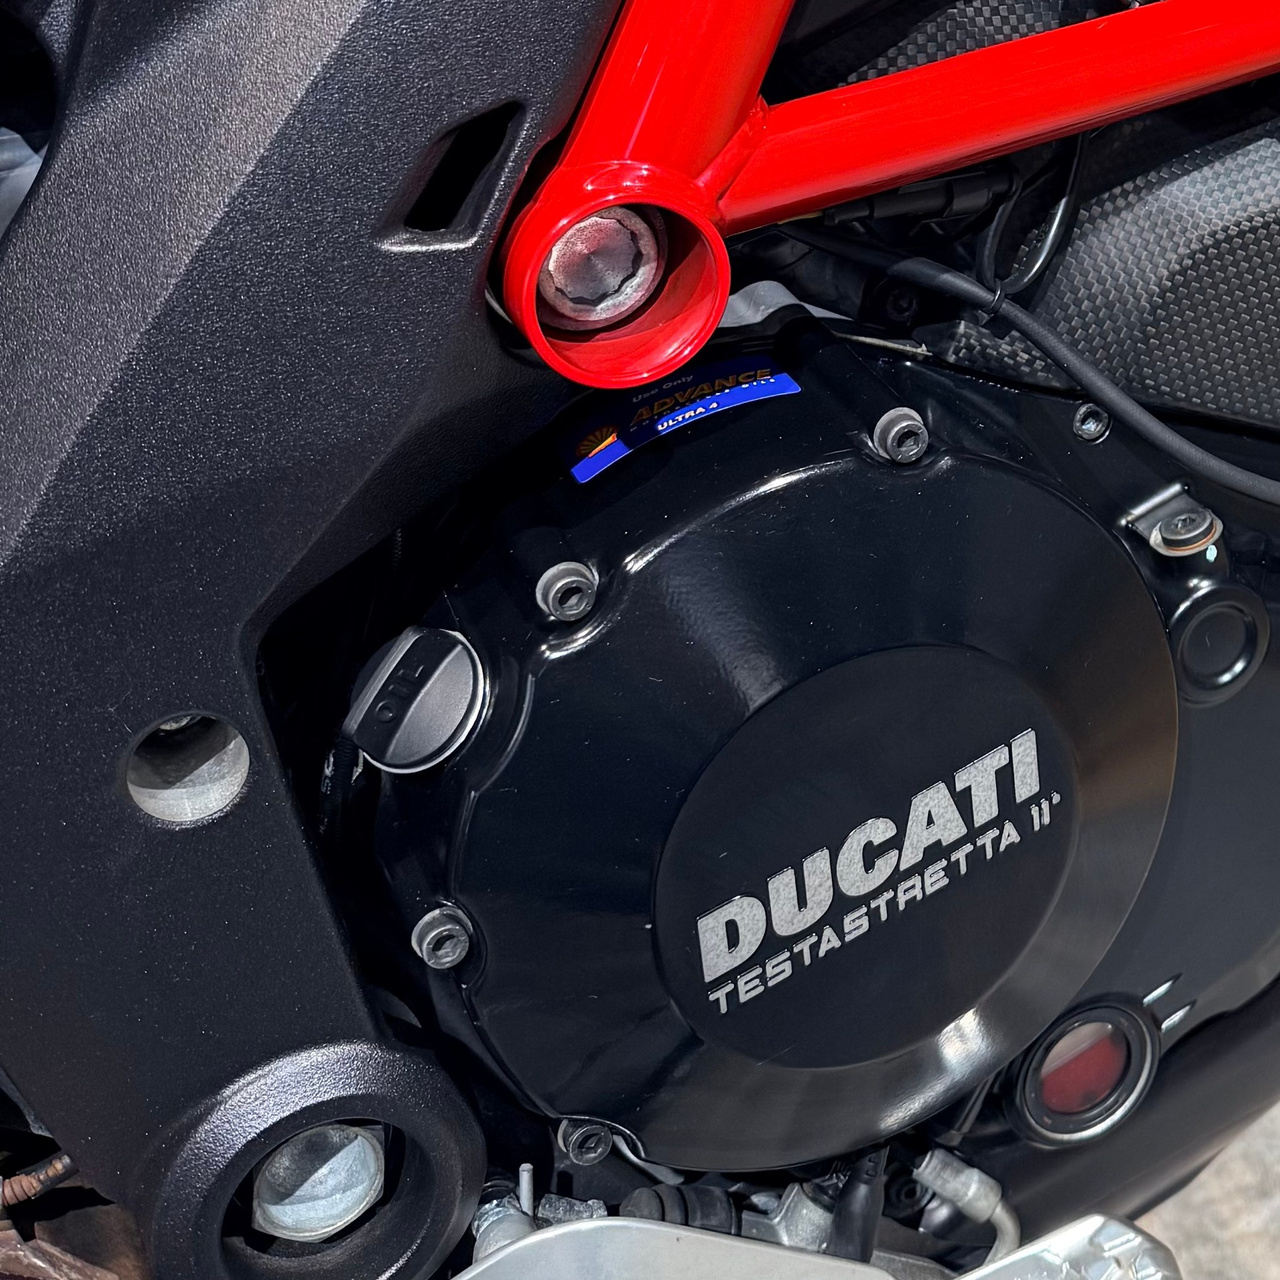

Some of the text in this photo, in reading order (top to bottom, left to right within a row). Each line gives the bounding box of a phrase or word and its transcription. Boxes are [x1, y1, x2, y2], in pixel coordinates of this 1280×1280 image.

[629, 368, 772, 426] ADVANCE
[632, 375, 694, 403] Use Only
[657, 401, 720, 431] ULTRA 4
[374, 665, 424, 724] OIL
[696, 727, 1041, 983] DUCATI
[708, 820, 1022, 1015] TESTASTRETTA
